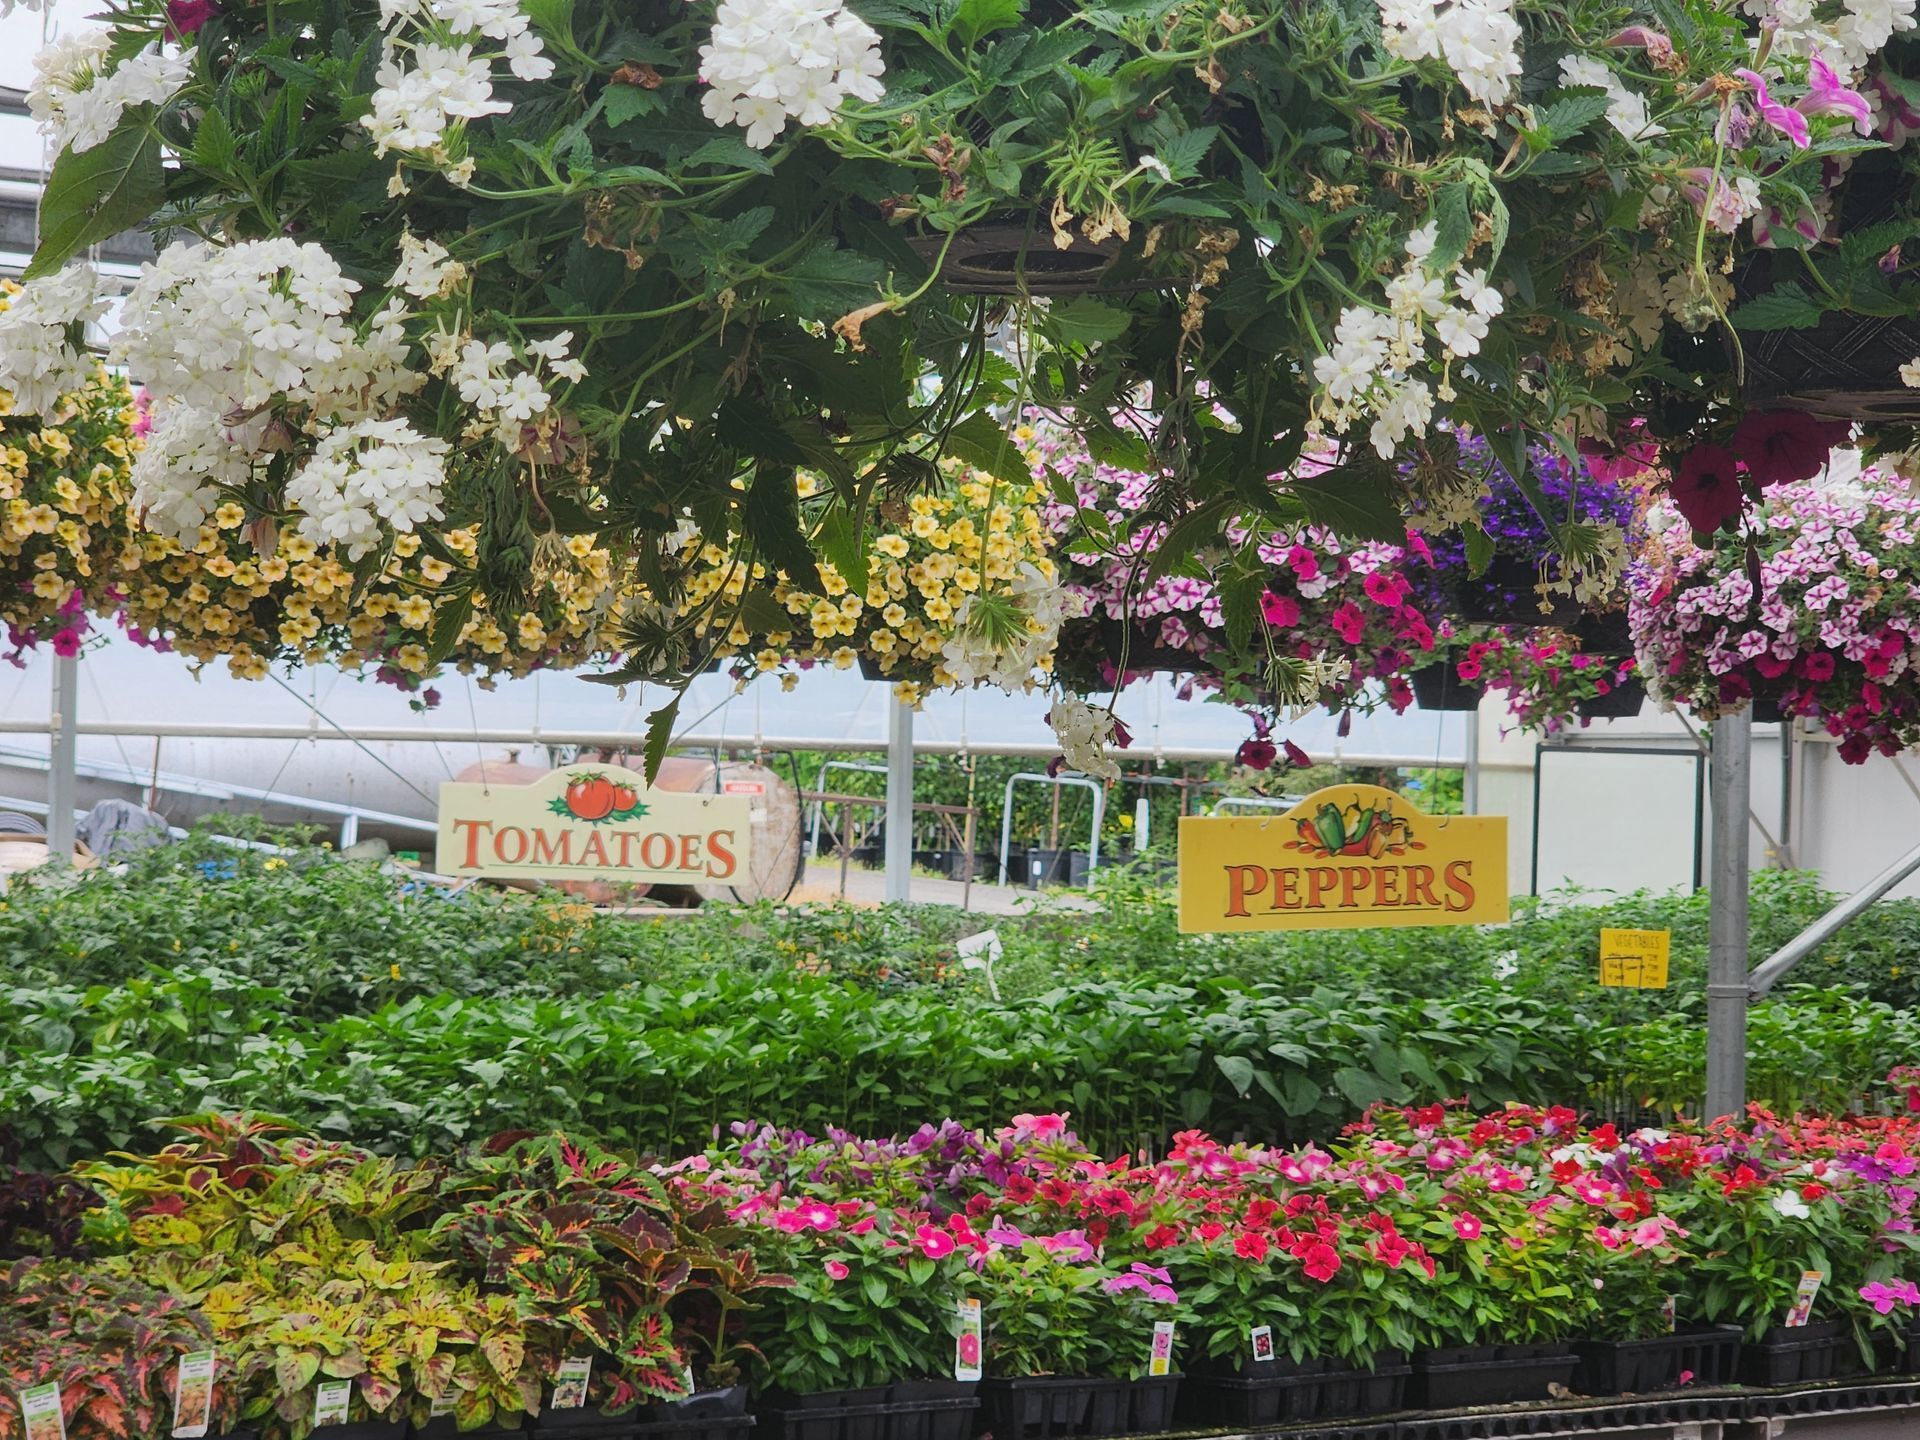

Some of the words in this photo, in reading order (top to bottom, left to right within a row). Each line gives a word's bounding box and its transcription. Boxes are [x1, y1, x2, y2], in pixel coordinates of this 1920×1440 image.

[453, 818, 737, 879] TOMATOES
[1223, 860, 1476, 918] PEPPERS
[1614, 933, 1660, 949] VEGETABLES
